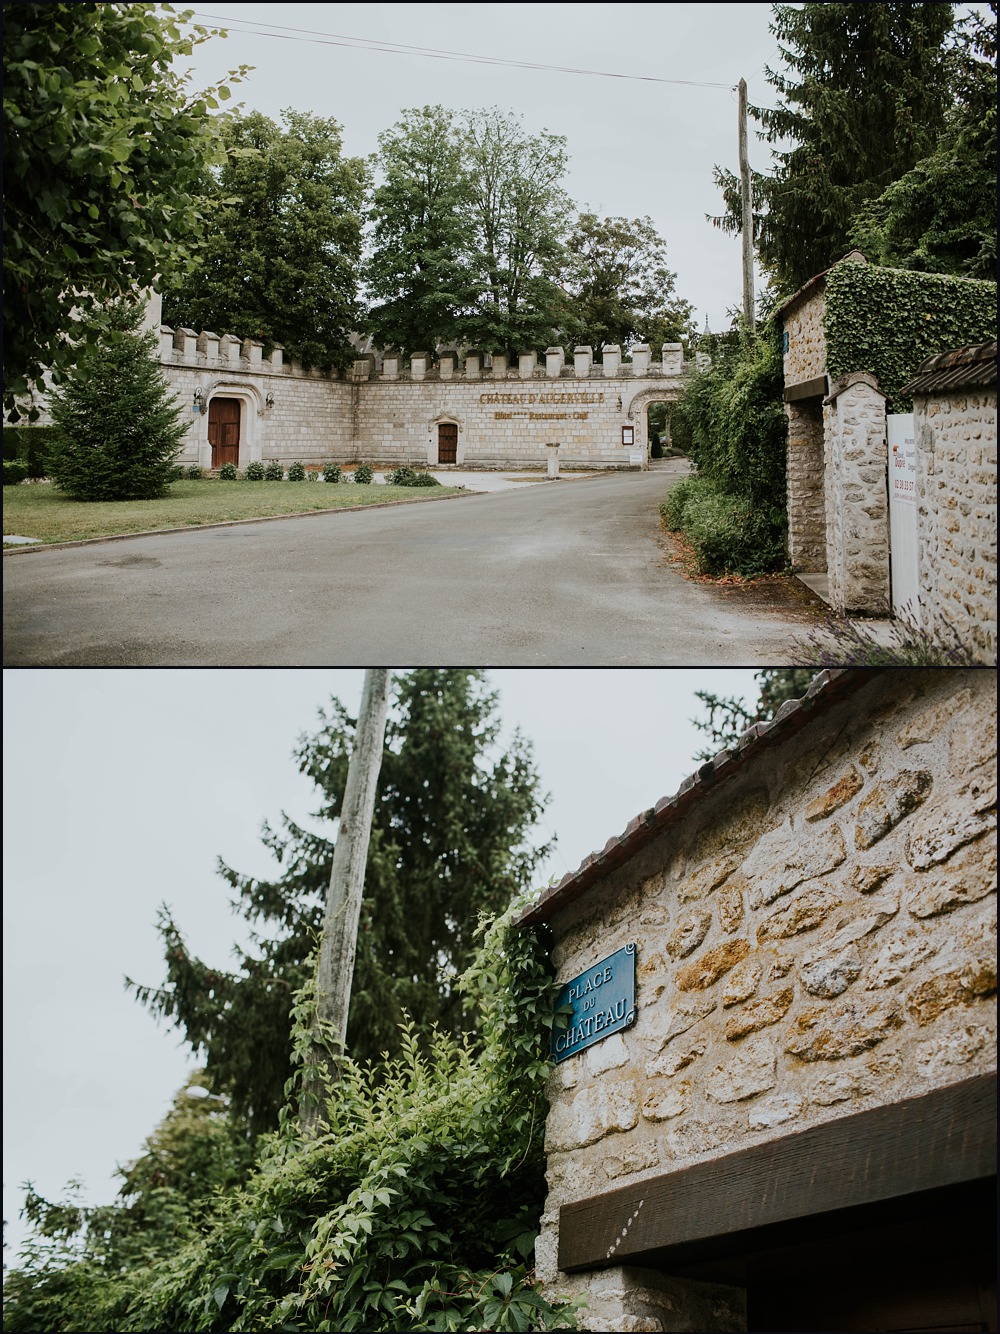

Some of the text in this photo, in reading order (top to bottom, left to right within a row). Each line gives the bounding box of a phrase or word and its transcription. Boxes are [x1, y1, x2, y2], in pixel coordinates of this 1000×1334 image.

[480, 392, 604, 404] CHÂTEAU D'AUGERVILLE
[529, 411, 567, 420] Restaurant
[568, 965, 613, 1004] PLACE
[583, 997, 596, 1012] DU
[555, 998, 627, 1053] CHÂTEAU
